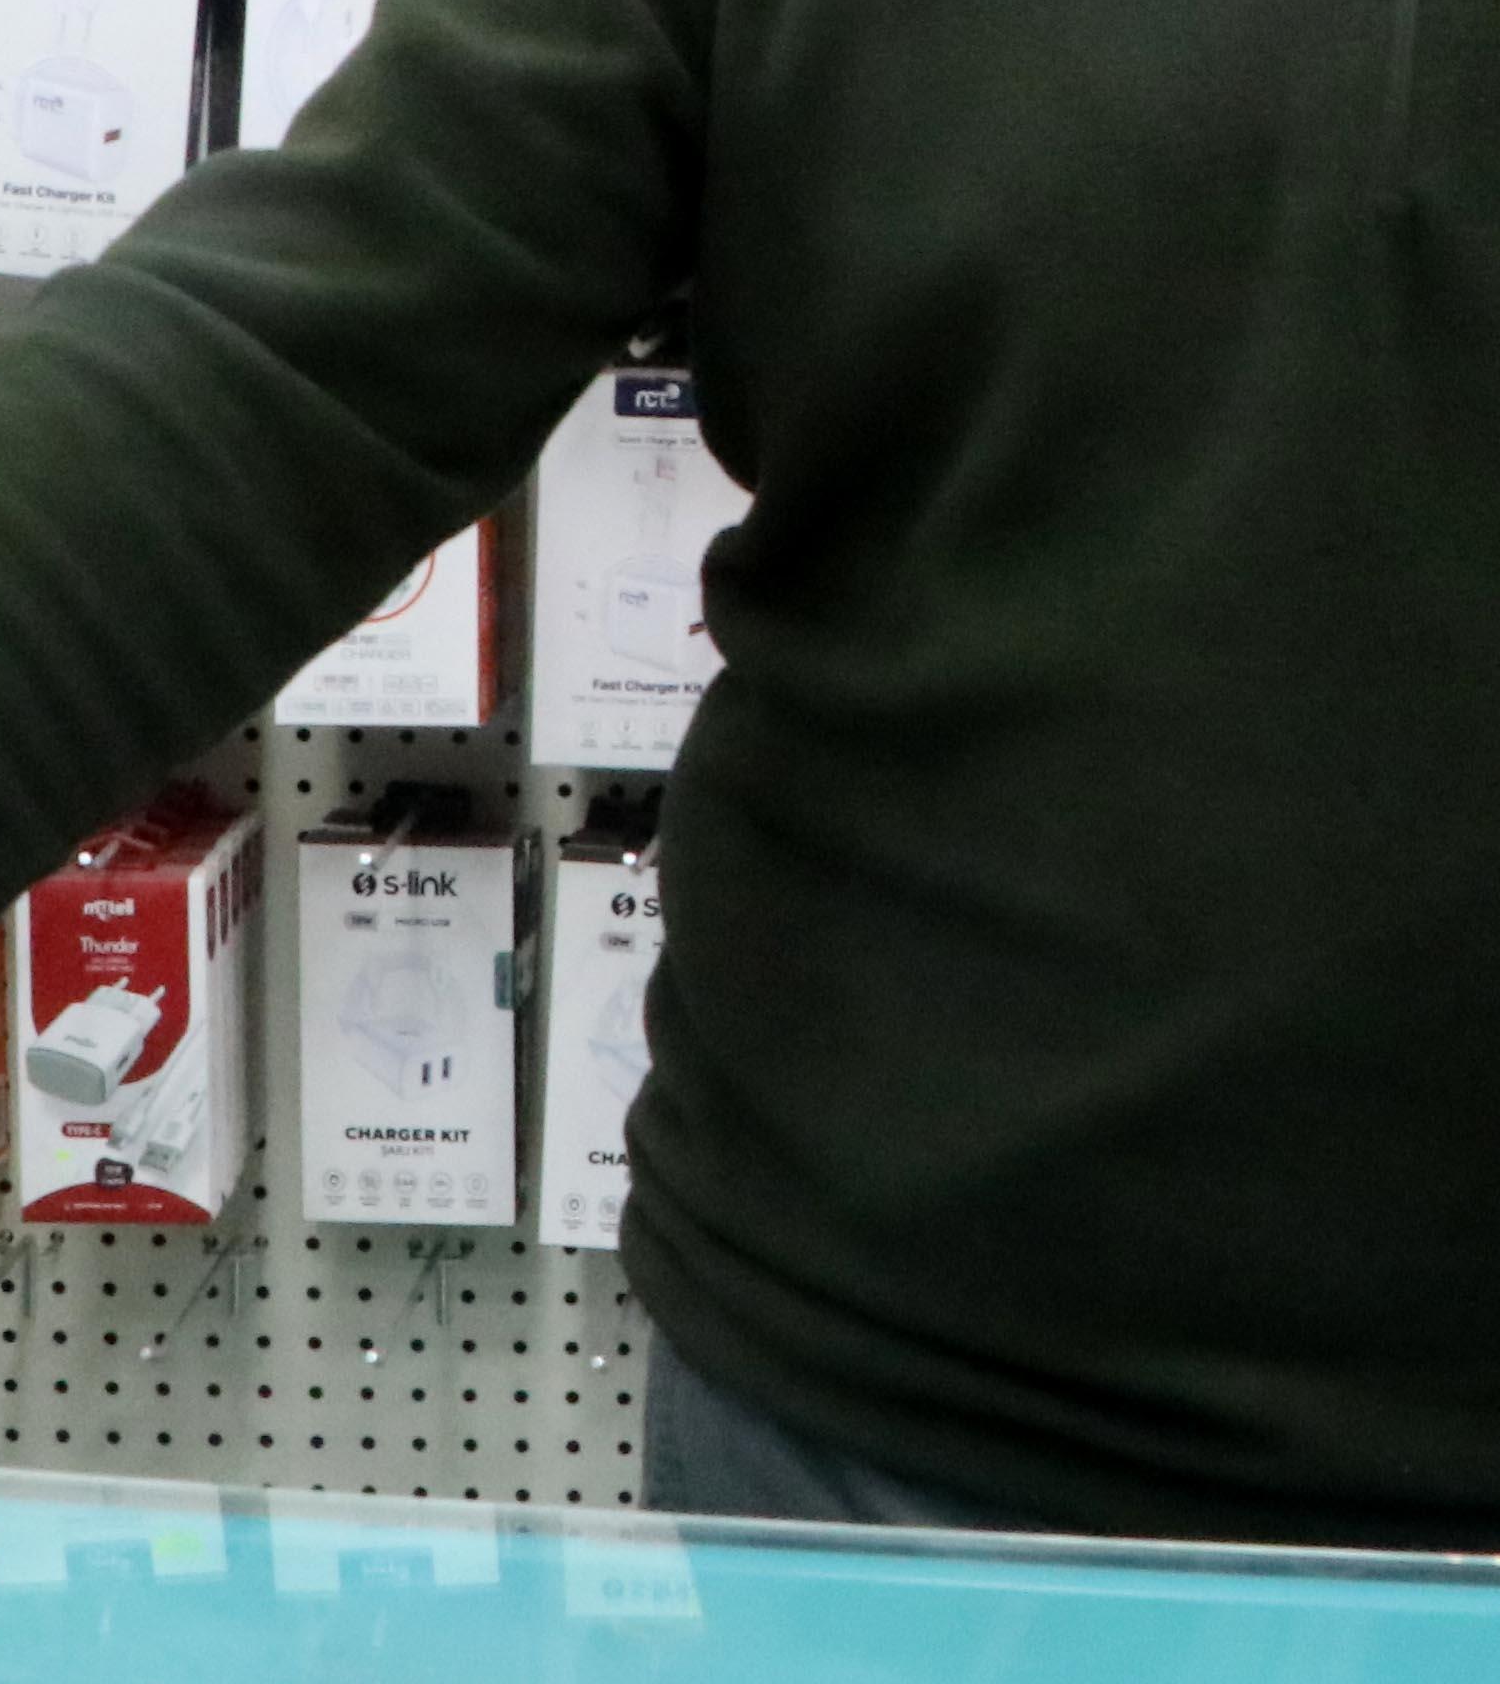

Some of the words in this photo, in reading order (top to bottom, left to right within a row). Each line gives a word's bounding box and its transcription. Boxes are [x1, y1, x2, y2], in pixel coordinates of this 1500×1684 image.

[384, 871, 458, 897] s-link
[79, 936, 139, 955] Thunder
[345, 1126, 436, 1144] CHARGER
[441, 1127, 470, 1144] KIT
